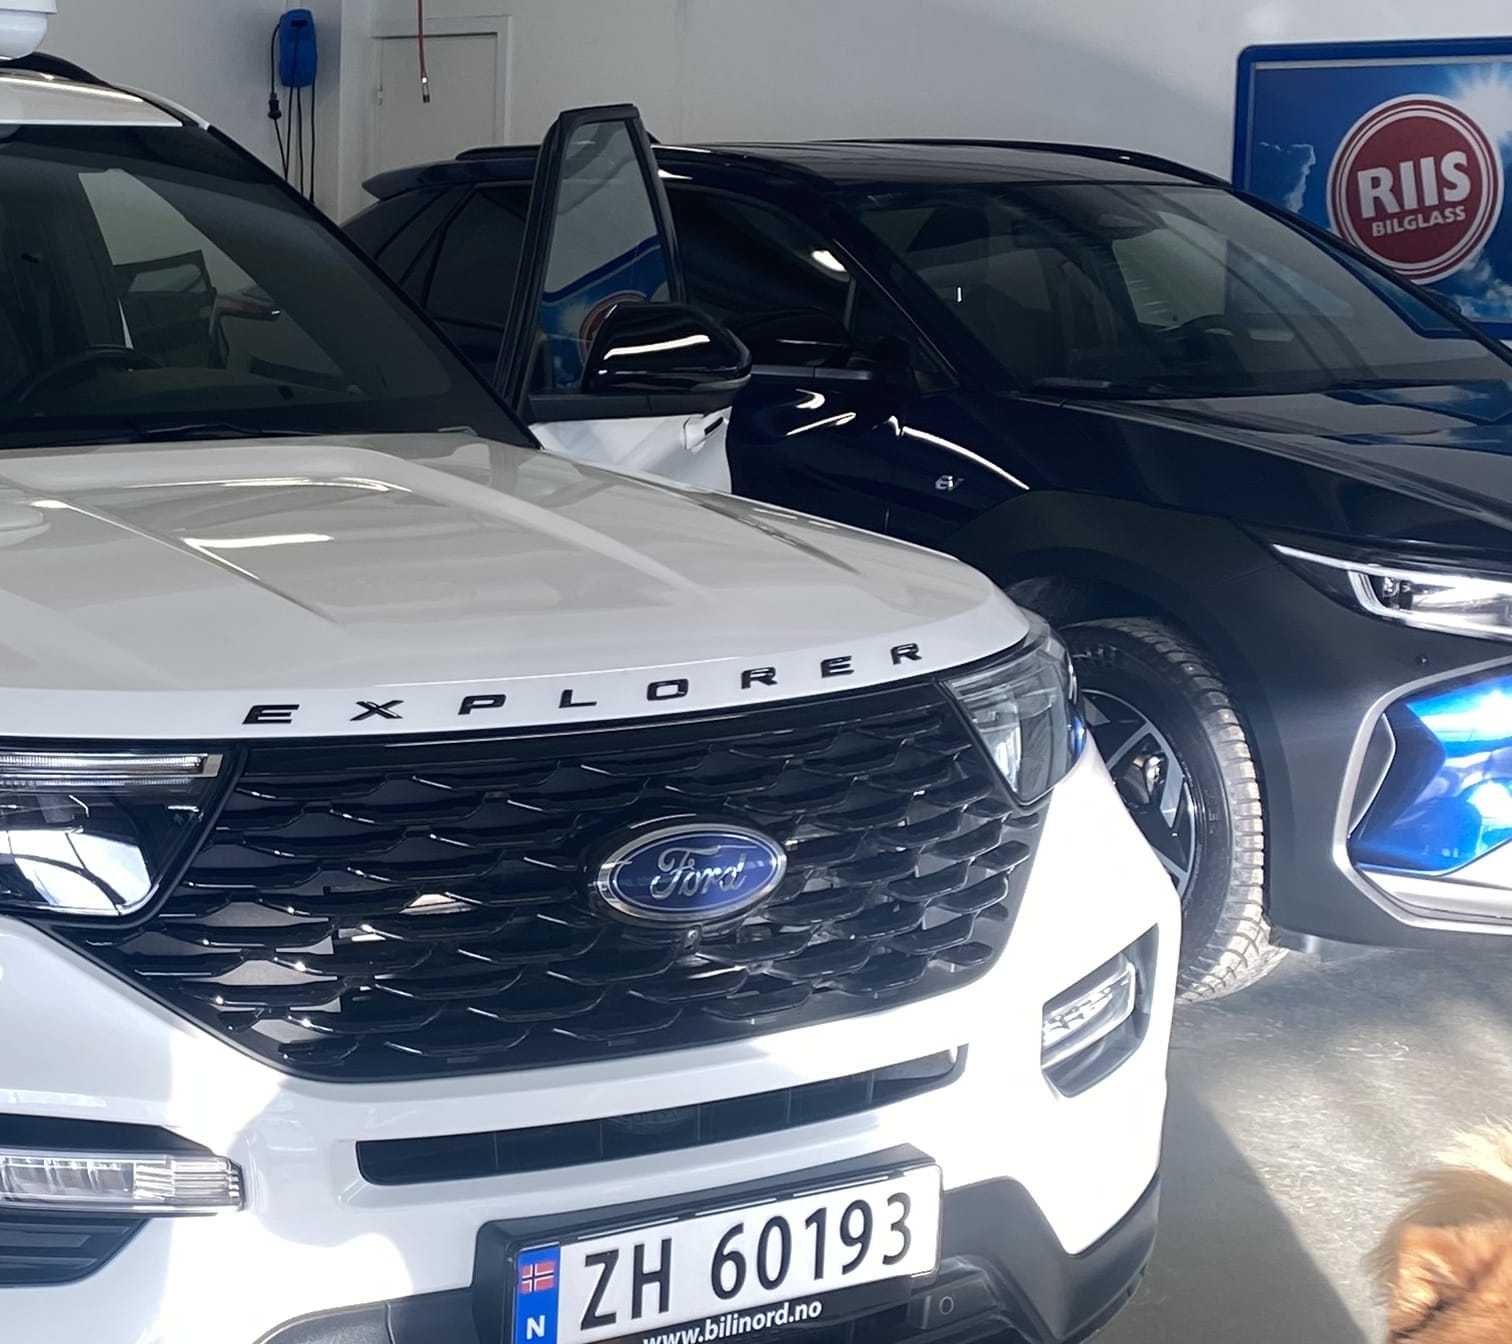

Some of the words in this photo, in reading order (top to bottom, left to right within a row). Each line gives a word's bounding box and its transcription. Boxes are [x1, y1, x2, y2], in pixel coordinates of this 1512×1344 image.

[1356, 150, 1472, 219] RIIS
[1372, 206, 1467, 238] BILGLASS
[242, 641, 924, 726] EXPLORER
[649, 844, 757, 901] Ford
[579, 1237, 673, 1331] ZH
[709, 1192, 913, 1301] 60193
[525, 1316, 546, 1340] N
